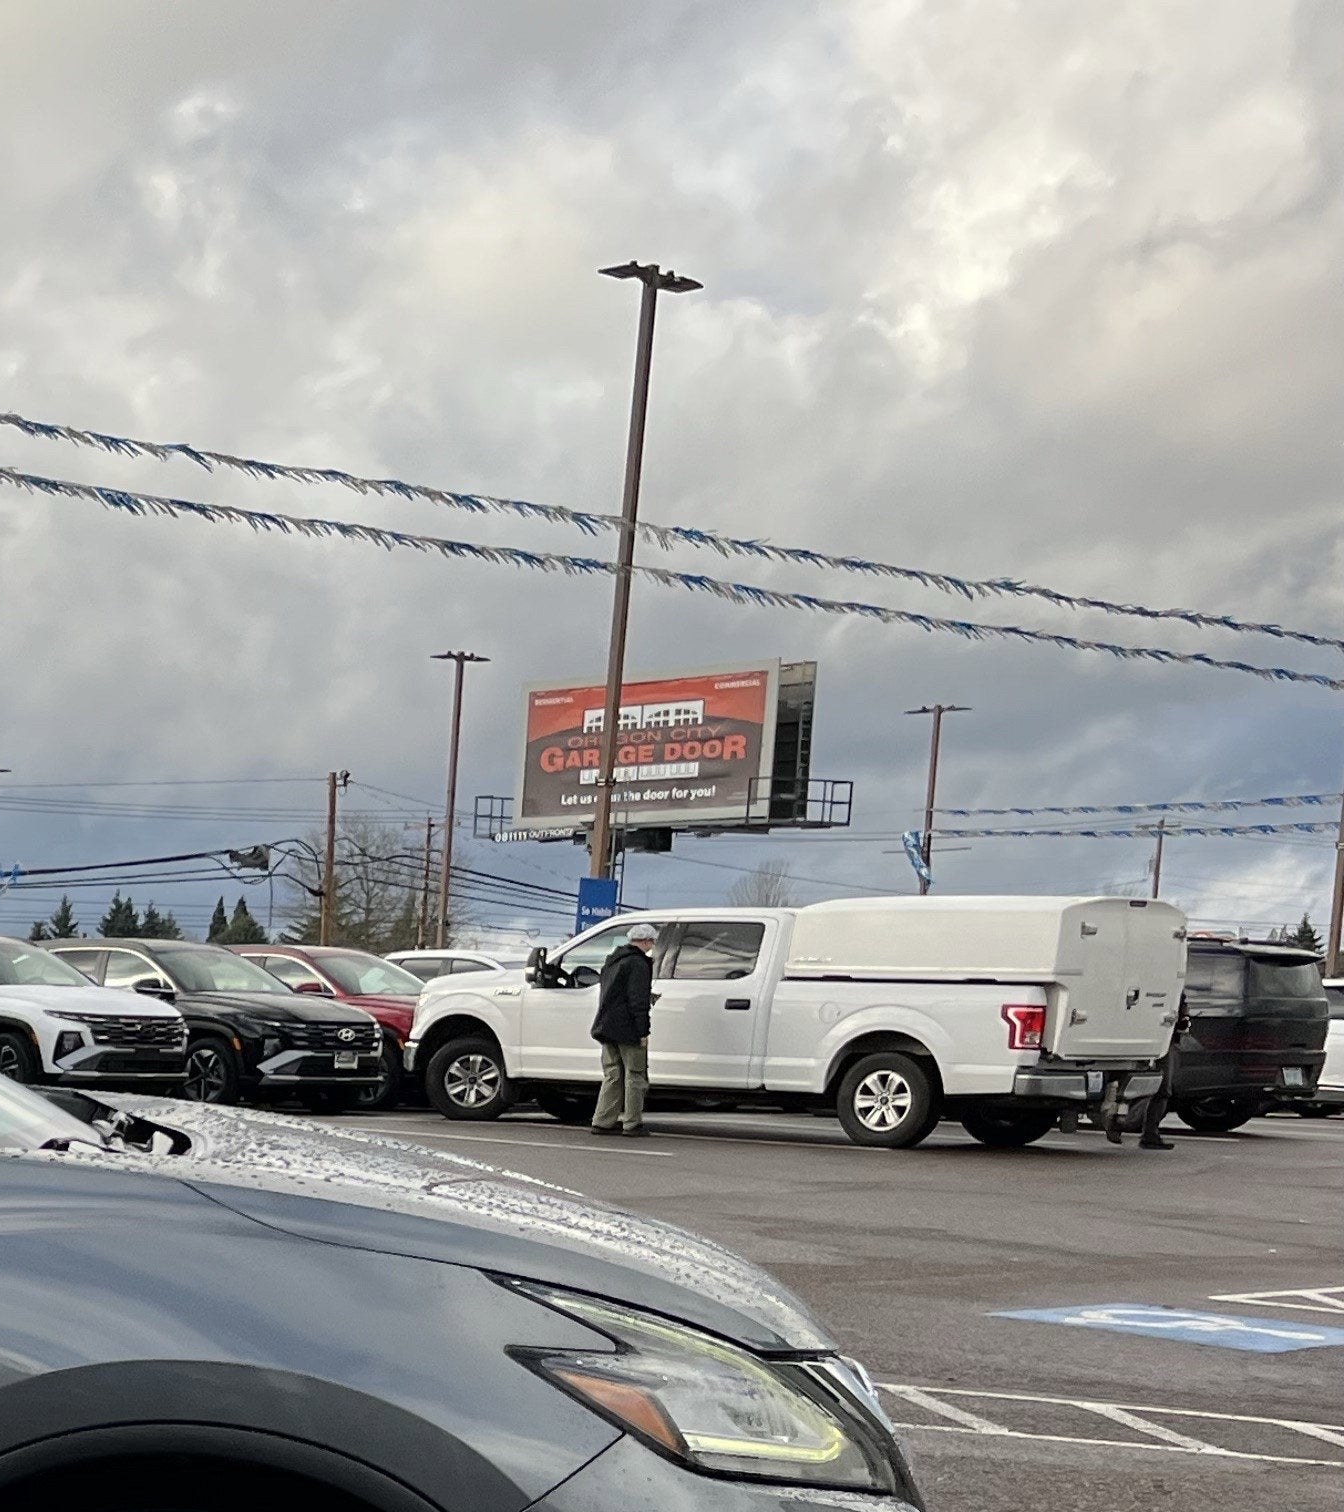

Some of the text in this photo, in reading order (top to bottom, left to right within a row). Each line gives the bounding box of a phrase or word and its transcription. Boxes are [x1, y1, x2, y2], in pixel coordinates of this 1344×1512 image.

[670, 727, 721, 741] CITY
[540, 734, 747, 773] GARGE DOOR
[561, 794, 577, 805] Let
[579, 795, 592, 804] us
[622, 790, 641, 803] the
[643, 788, 669, 801] door
[672, 787, 689, 800] for
[690, 786, 716, 801] you!
